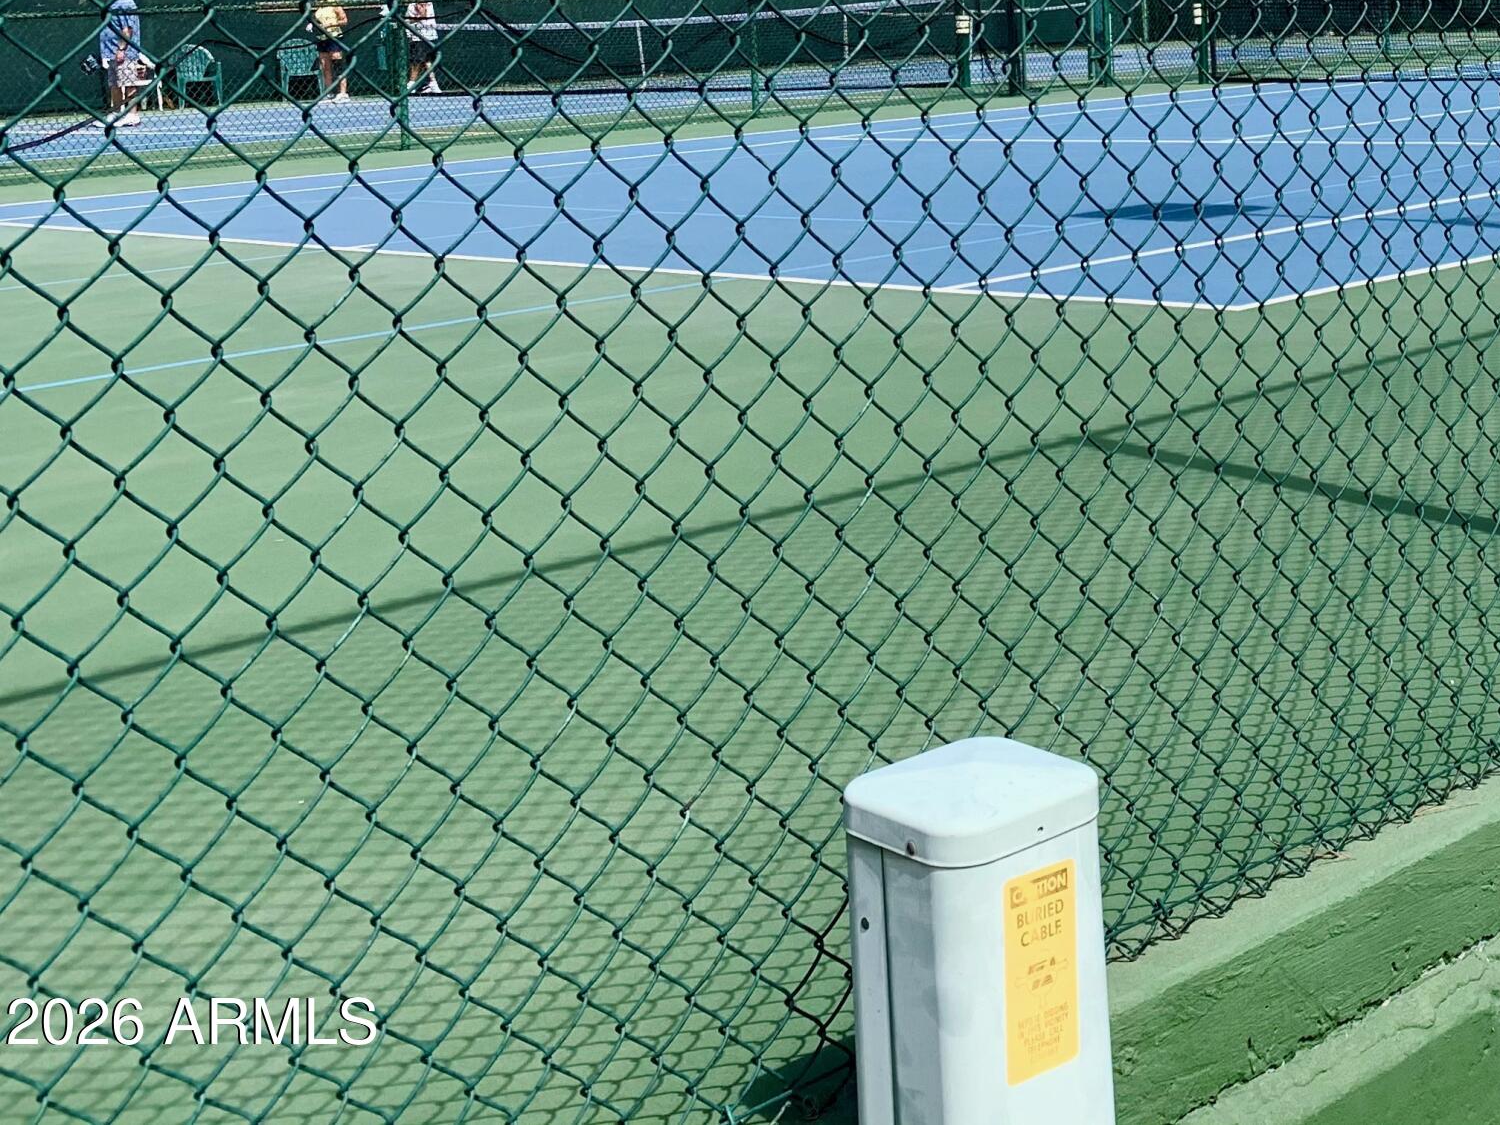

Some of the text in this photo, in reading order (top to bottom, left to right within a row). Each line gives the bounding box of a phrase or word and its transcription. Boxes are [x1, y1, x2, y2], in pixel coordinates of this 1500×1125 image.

[1012, 871, 1067, 904] CTION
[1016, 898, 1064, 929] BURIED
[1020, 919, 1061, 947] CABLE
